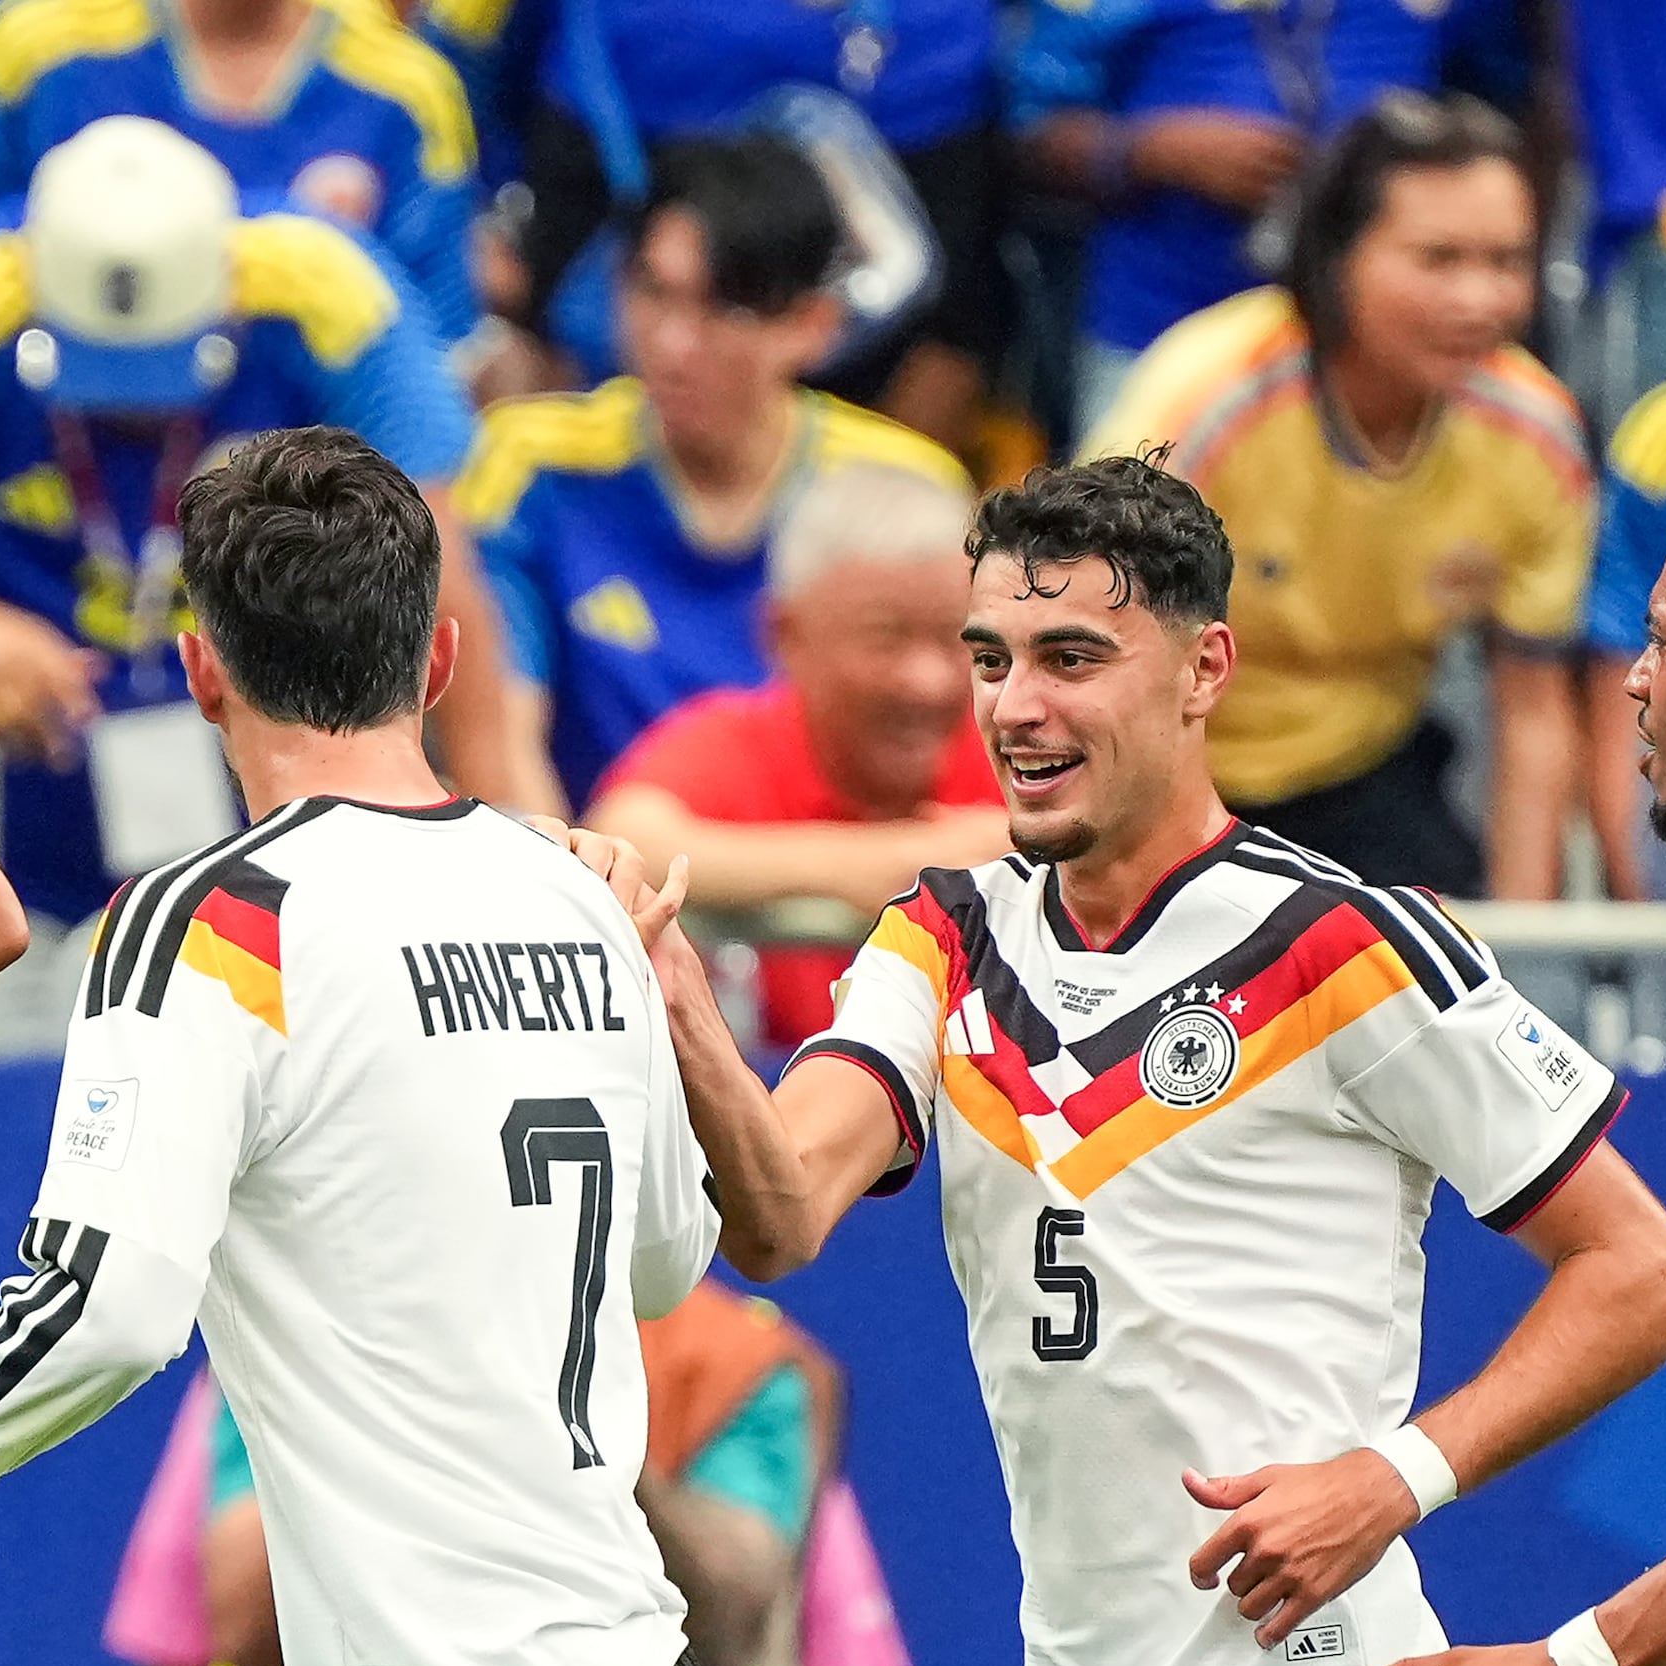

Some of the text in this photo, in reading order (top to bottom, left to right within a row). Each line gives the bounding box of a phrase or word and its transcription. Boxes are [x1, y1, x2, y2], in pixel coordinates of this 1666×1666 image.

[401, 942, 625, 1036] HAVERTZ
[1167, 1020, 1219, 1040] DEUTSCHER
[64, 1131, 110, 1151] PEACE
[500, 1097, 614, 1469] 7
[1033, 1205, 1099, 1362] 5
